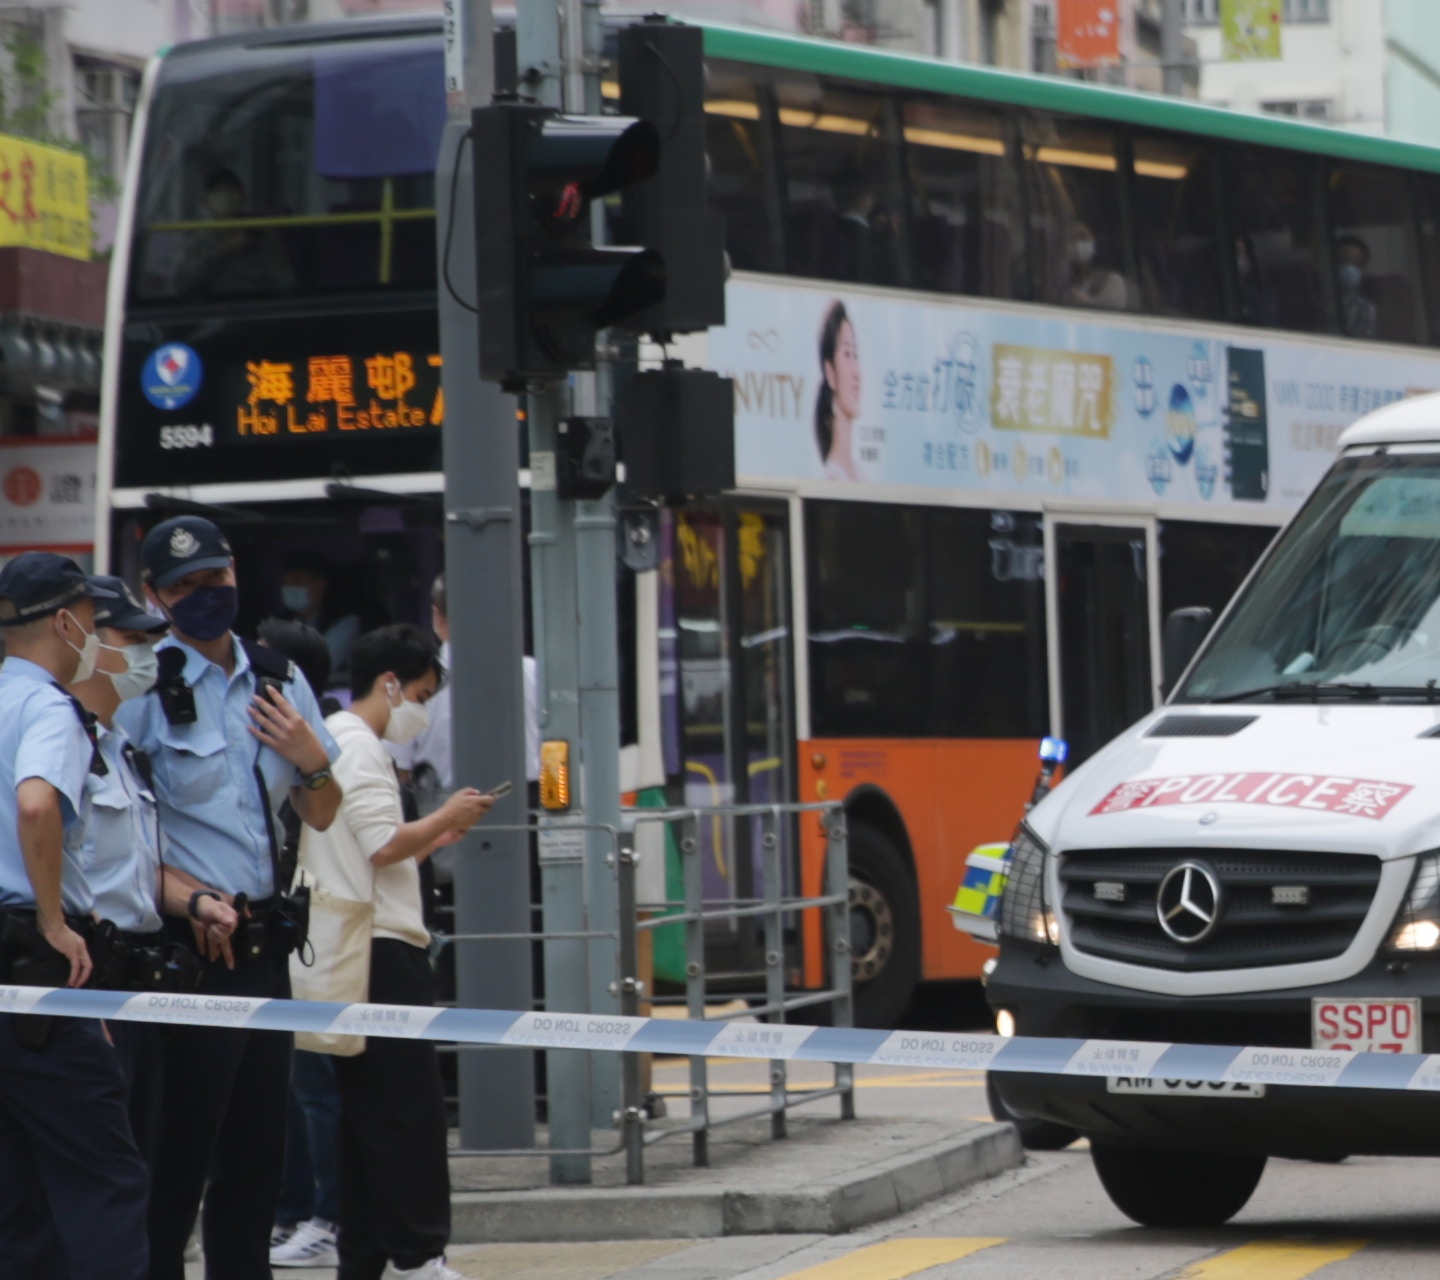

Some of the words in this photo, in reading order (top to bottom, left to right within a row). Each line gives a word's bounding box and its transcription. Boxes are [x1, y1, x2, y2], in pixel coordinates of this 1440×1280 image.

[246, 352, 415, 405] 海麗邨
[995, 354, 1104, 432] 衰老魔咒
[237, 406, 278, 435] Hoi
[287, 404, 328, 433] Lai
[337, 397, 425, 431] Estate
[1140, 773, 1357, 810] POLICE
[1337, 782, 1402, 816] 察
